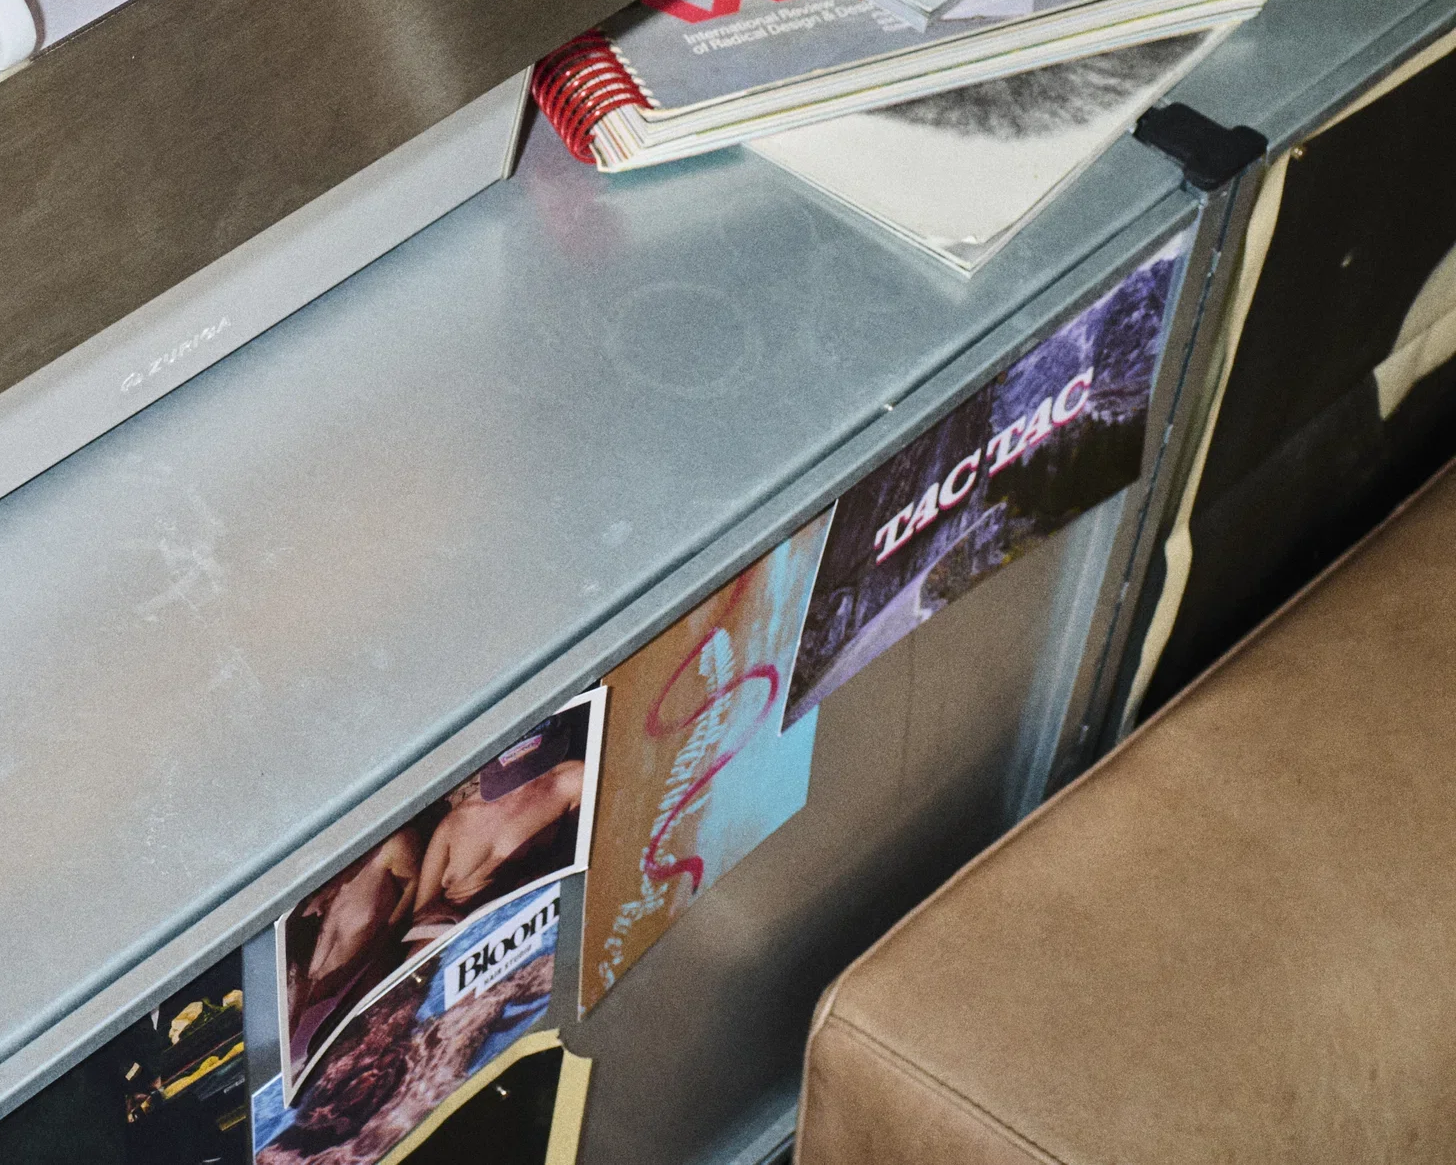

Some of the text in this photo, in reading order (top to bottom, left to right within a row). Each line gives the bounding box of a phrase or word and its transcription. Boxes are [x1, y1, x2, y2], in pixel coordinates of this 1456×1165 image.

[684, 0, 834, 45] International Review
[709, 27, 768, 50] Radical
[767, 14, 821, 35] Design
[873, 366, 1094, 566] TAC TAC
[458, 896, 561, 992] Bloom
